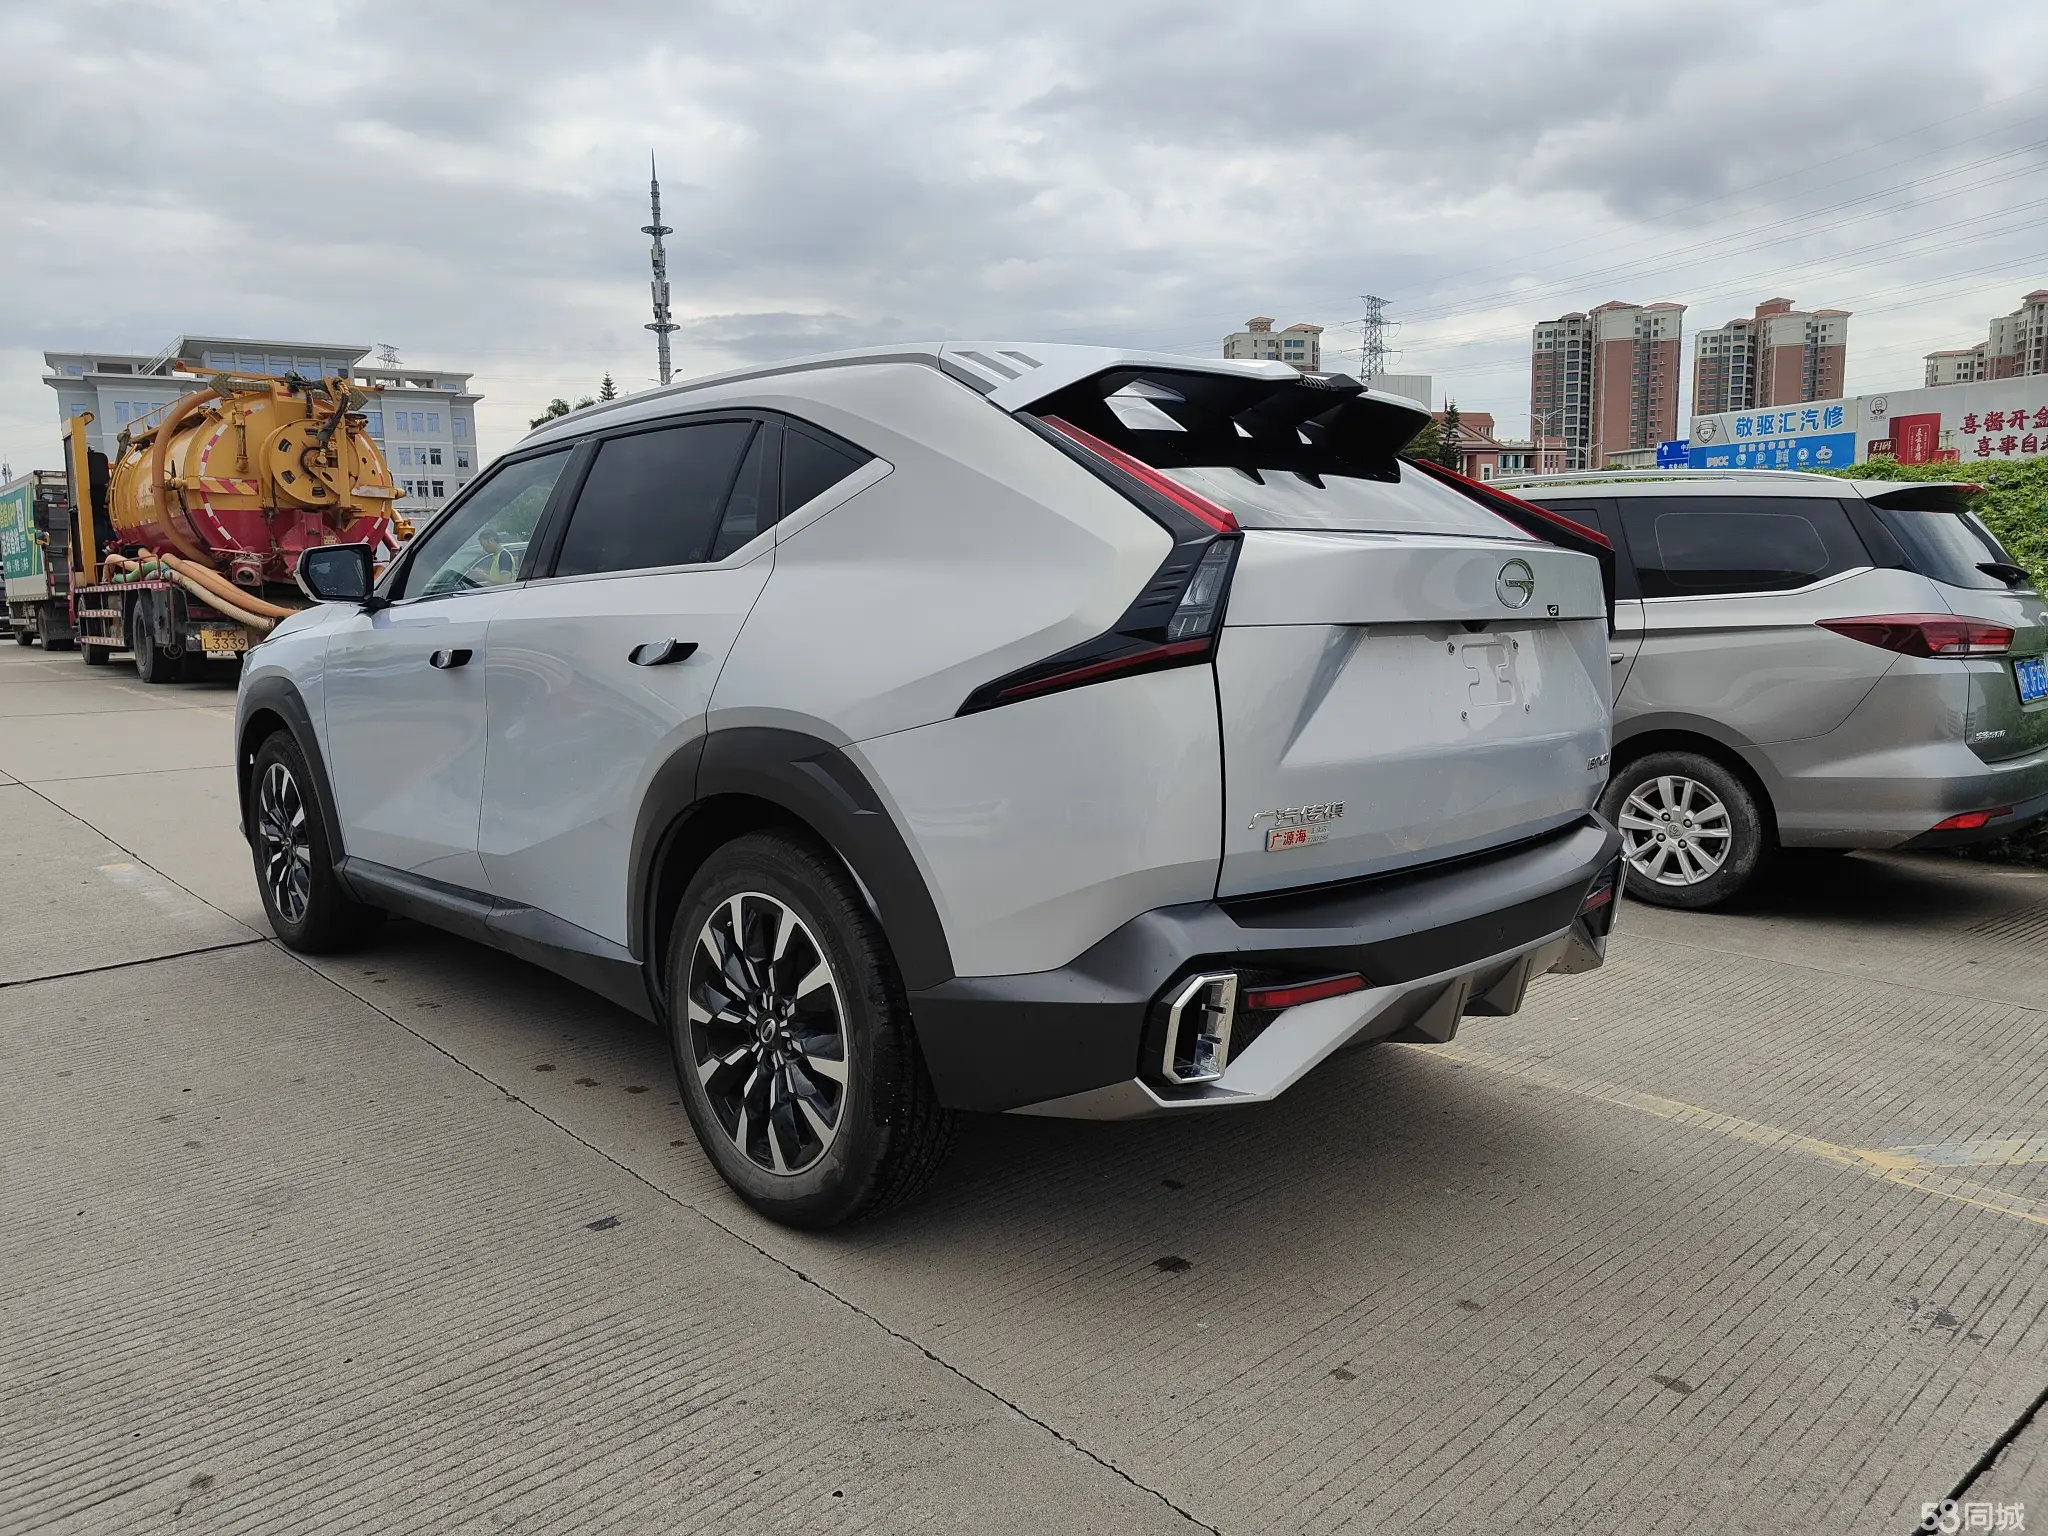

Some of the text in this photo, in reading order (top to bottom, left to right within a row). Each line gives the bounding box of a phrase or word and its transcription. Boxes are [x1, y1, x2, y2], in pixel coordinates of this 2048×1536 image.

[1735, 405, 1844, 438] 敬驱汇汽修
[1706, 455, 1729, 468] PICC
[203, 637, 246, 650] L3339
[1248, 800, 1346, 830] 广汽传祺
[1270, 829, 1307, 848] 广源海
